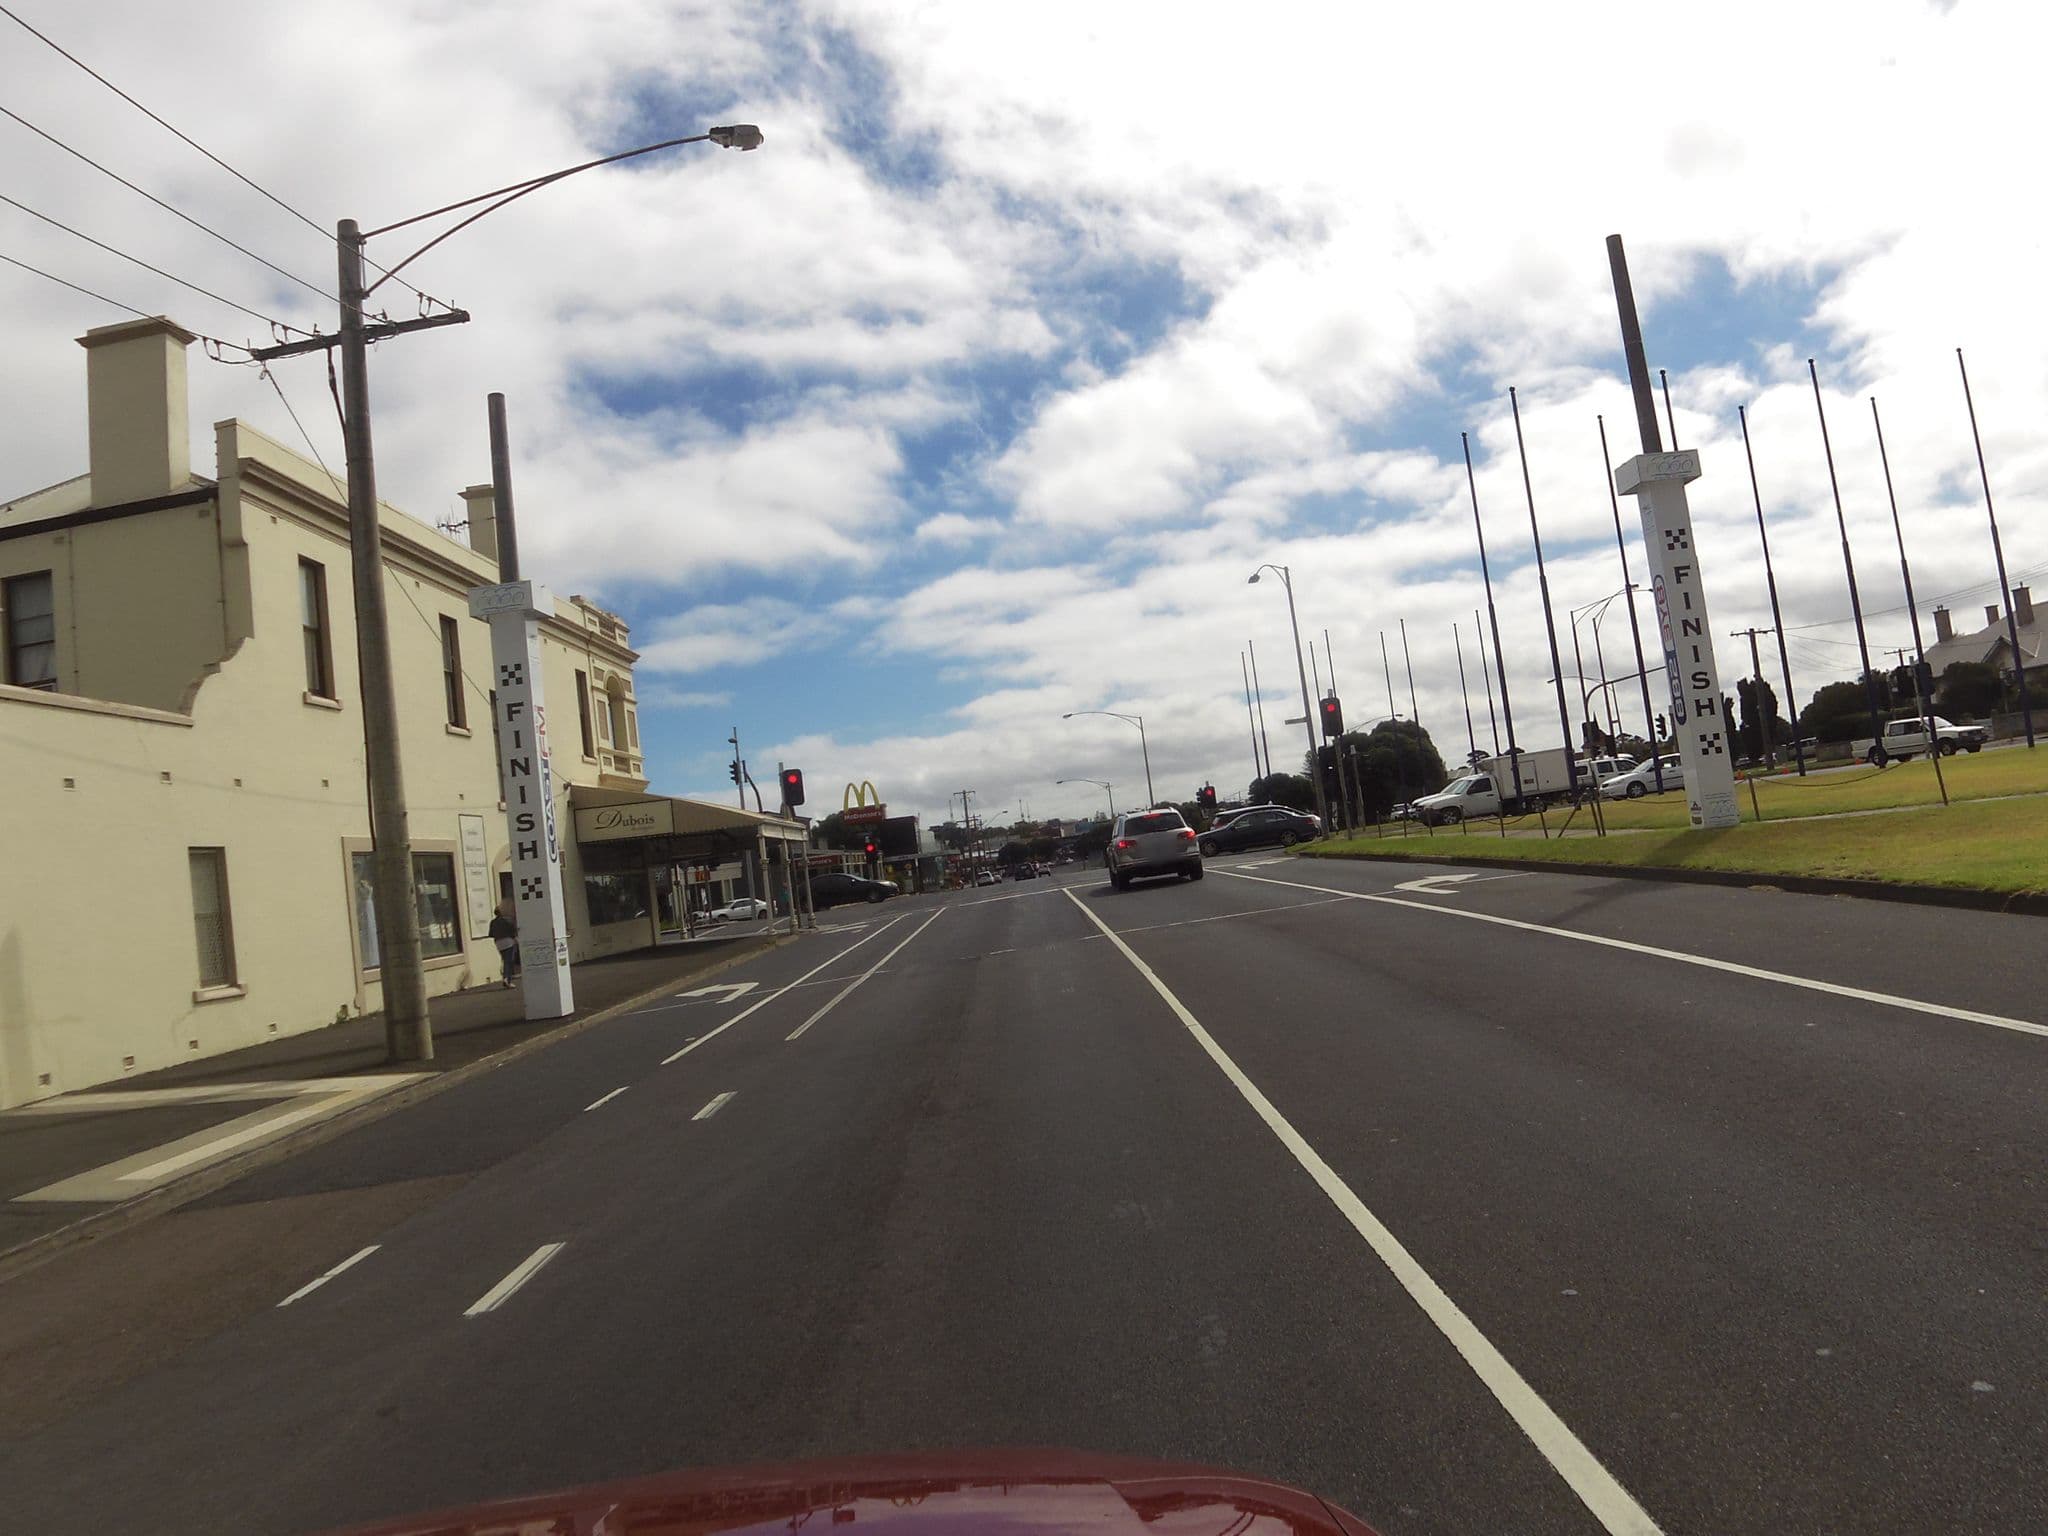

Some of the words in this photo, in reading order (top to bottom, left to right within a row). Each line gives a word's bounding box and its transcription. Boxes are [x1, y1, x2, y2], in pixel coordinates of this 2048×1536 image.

[1673, 566, 1716, 717] FINISH
[507, 703, 540, 860] FINISH
[594, 811, 656, 828] Dubois
